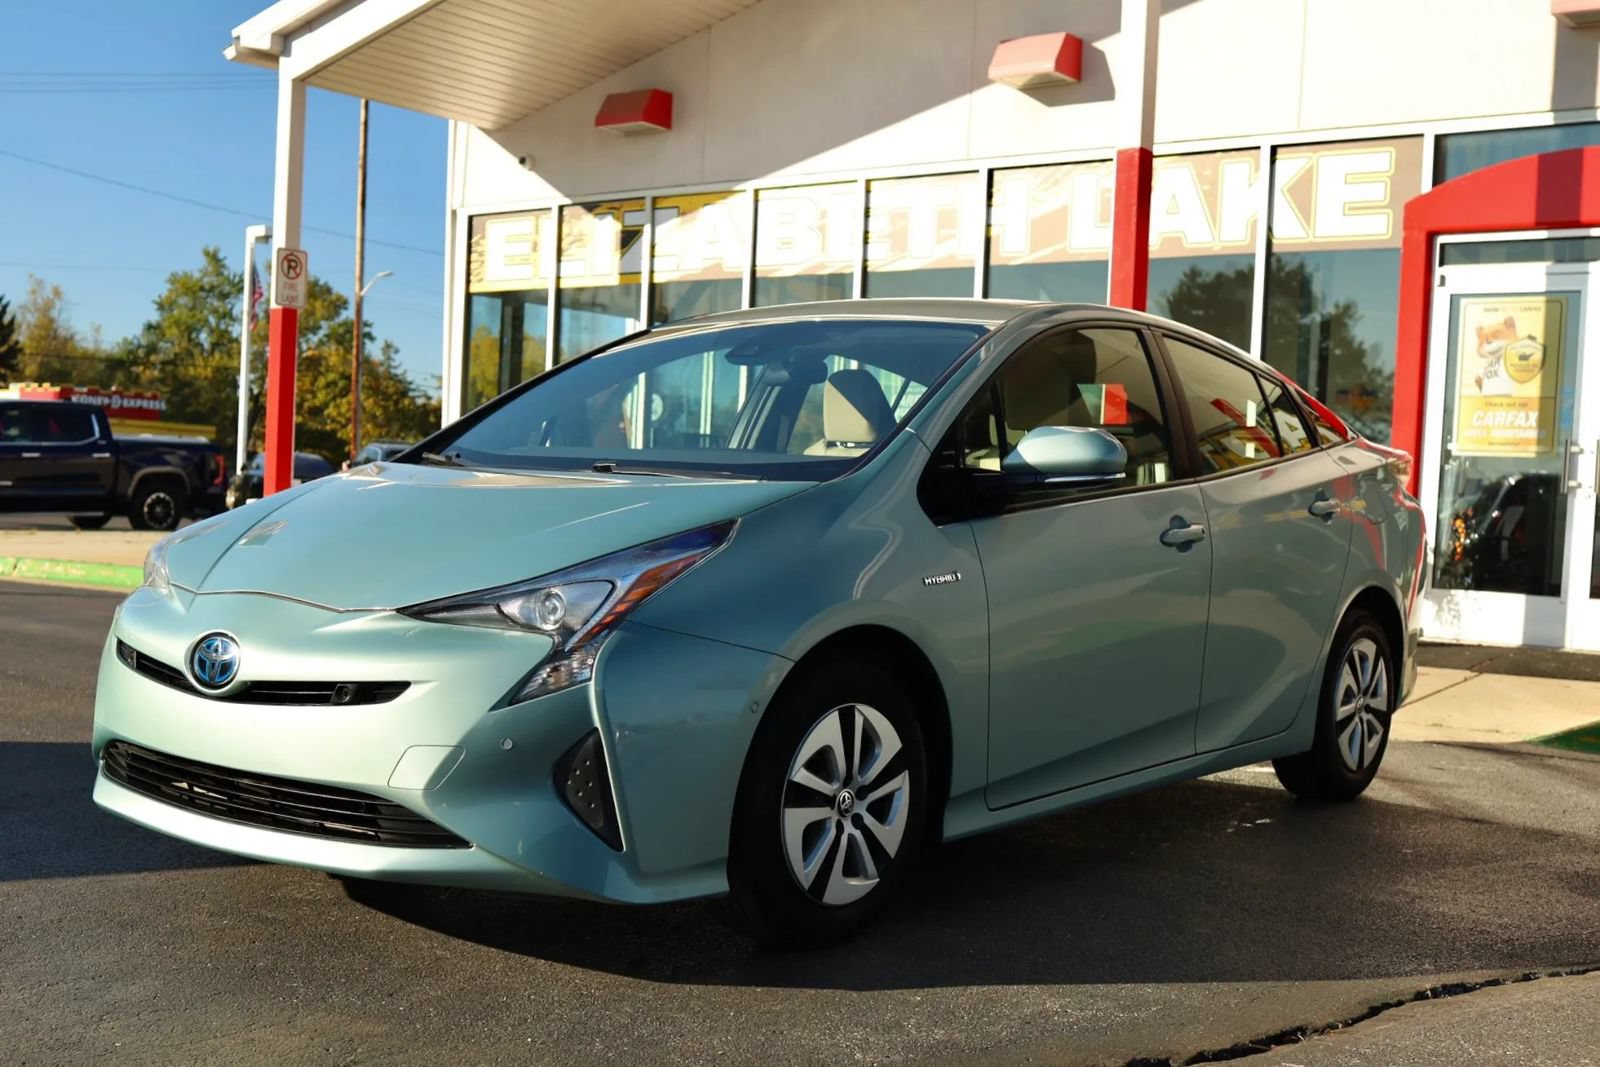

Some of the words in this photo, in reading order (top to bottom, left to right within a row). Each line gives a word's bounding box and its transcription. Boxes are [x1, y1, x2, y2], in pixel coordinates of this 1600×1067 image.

[485, 173, 1030, 282] ELIZABETH
[1067, 147, 1395, 251] LAKE
[123, 397, 167, 411] EXPRESS
[1472, 410, 1539, 428] CARFAX
[923, 573, 957, 586] HYBRID
